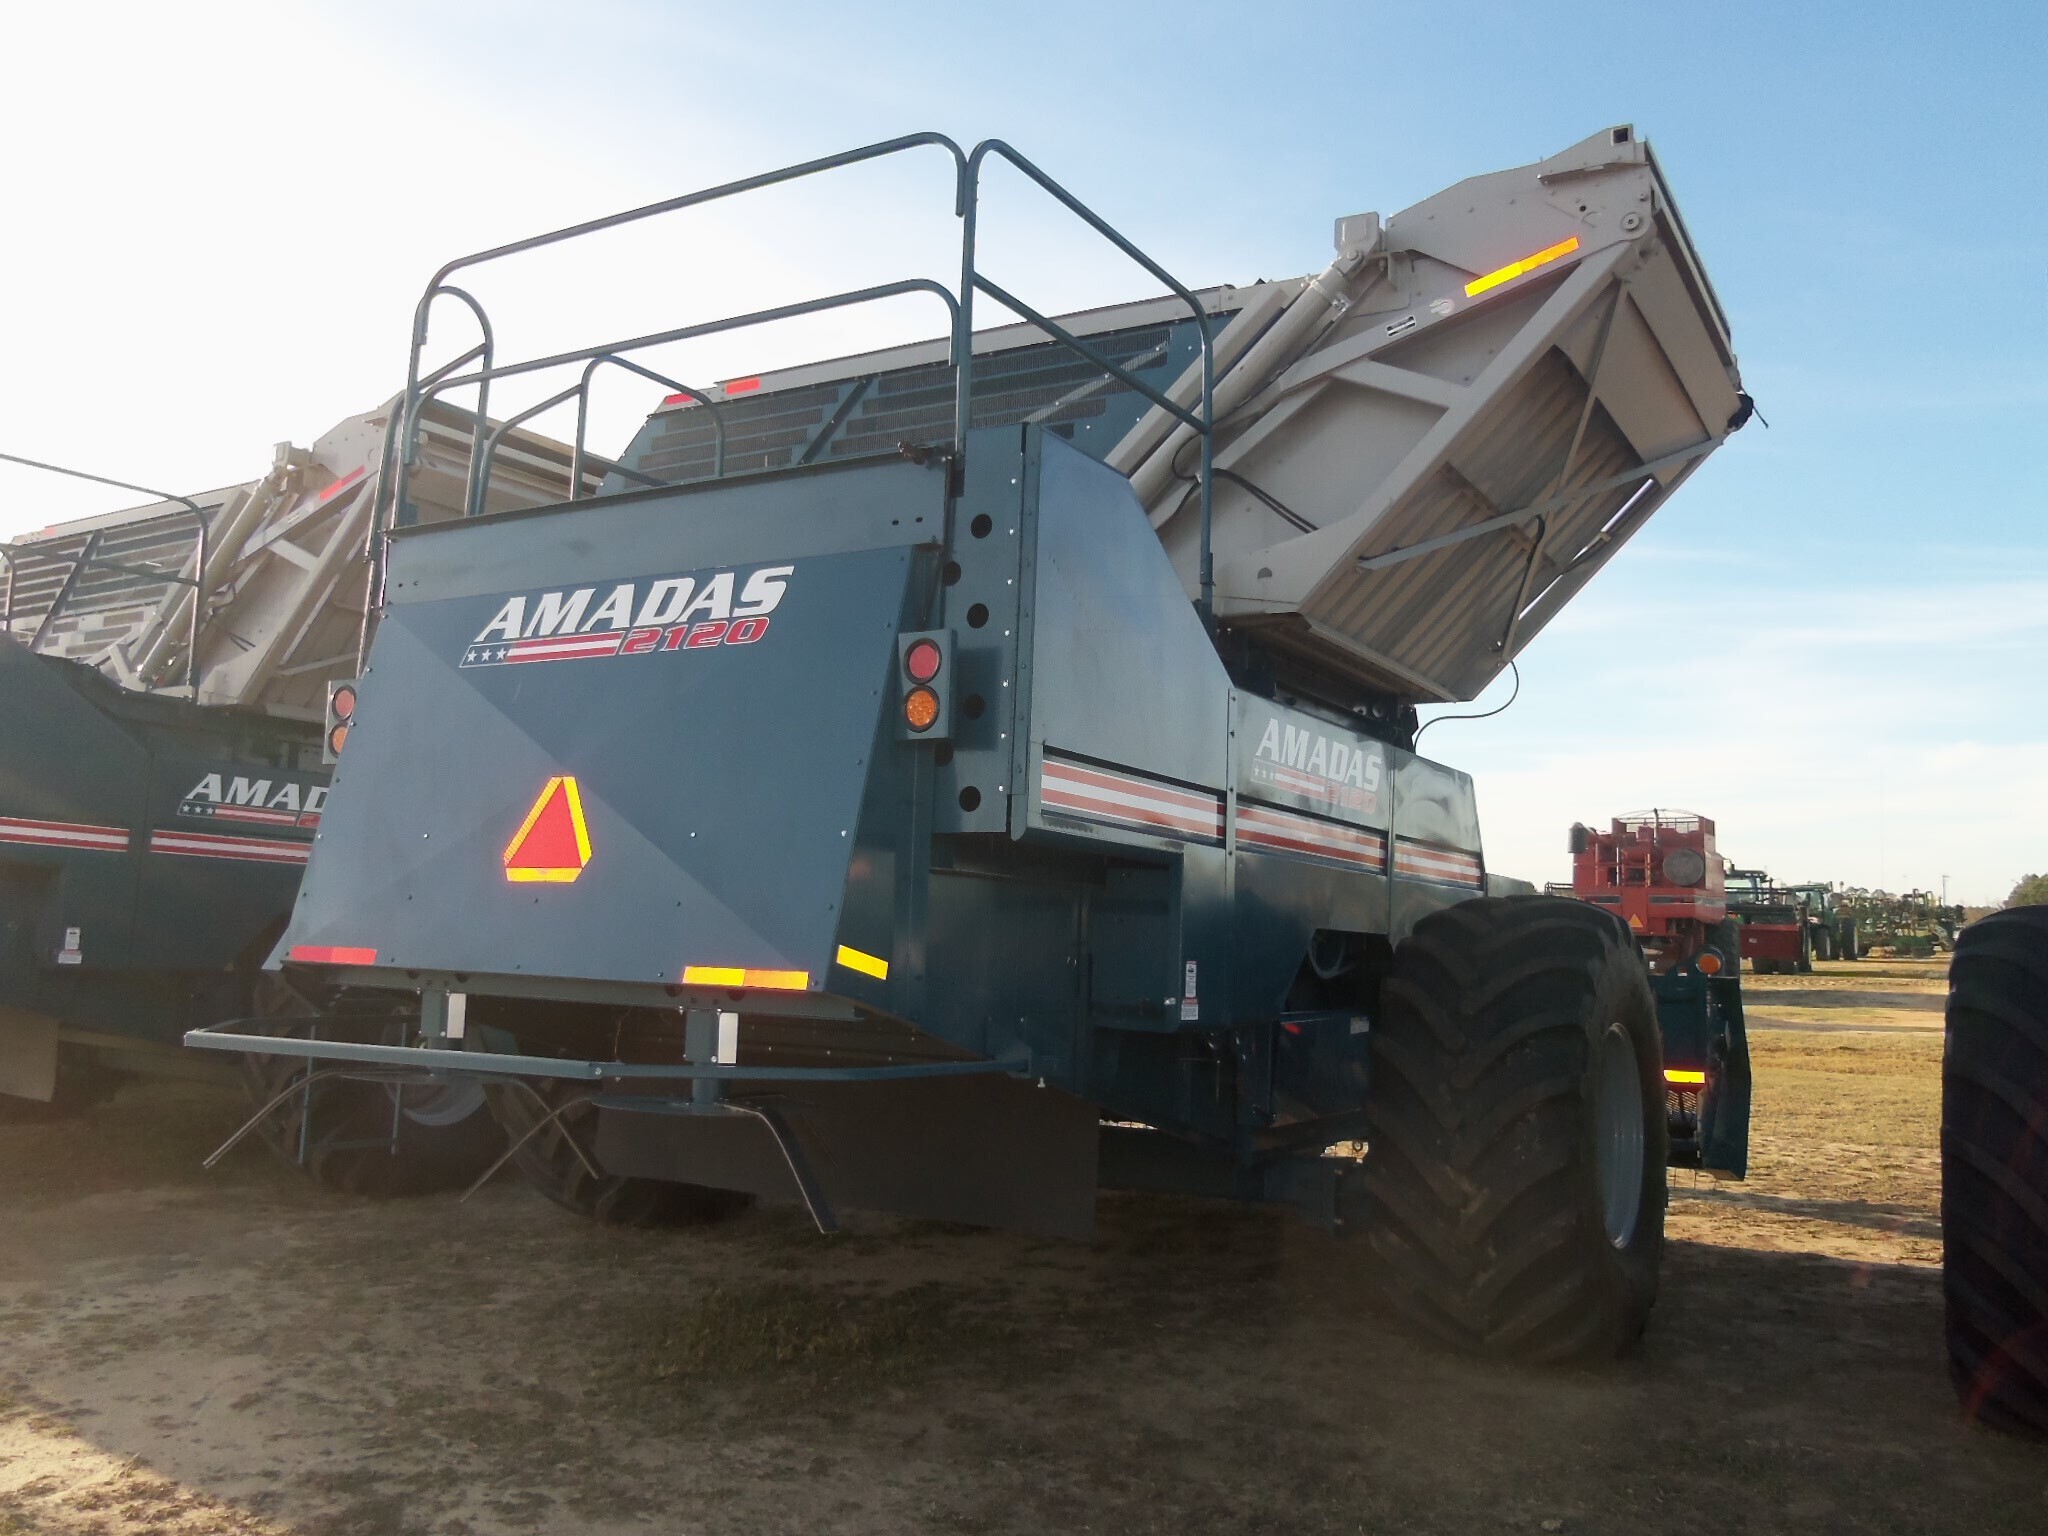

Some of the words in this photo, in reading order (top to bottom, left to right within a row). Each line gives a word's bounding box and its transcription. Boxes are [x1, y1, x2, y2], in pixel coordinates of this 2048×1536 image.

[474, 566, 795, 642] AMADAS
[619, 617, 770, 655] 2120
[1254, 718, 1382, 792] AMADAS
[185, 772, 330, 813] AMAD
